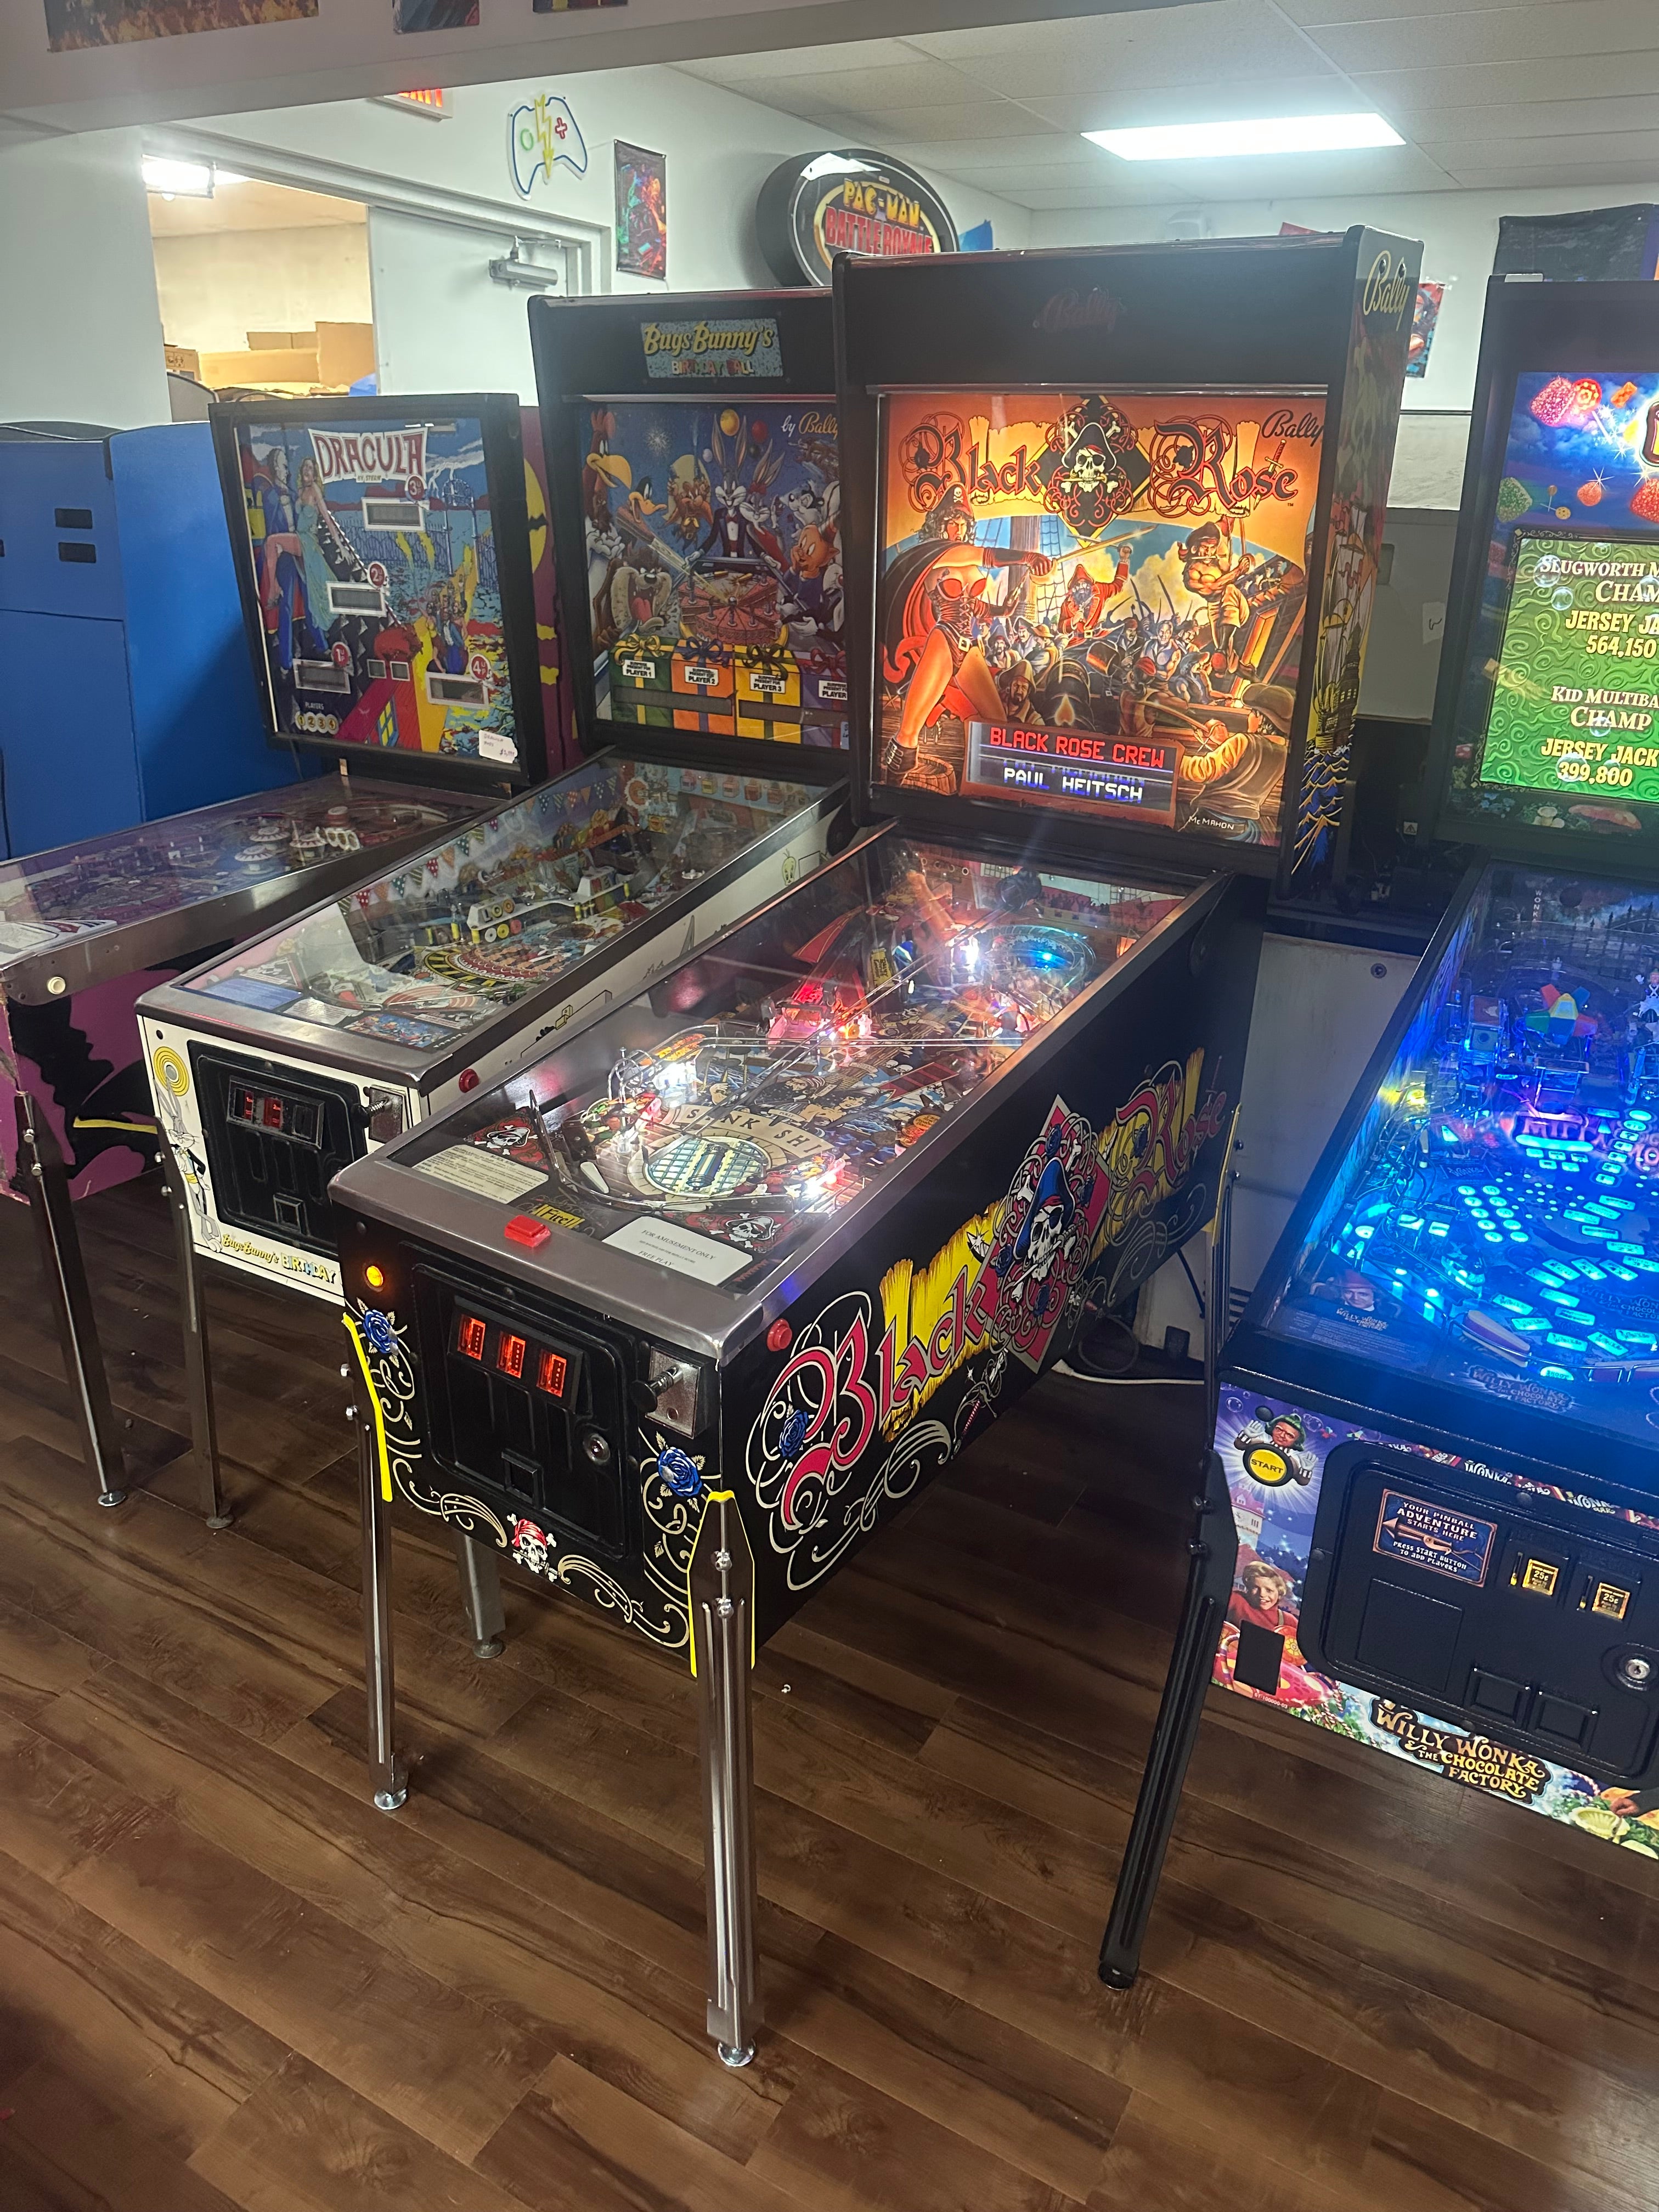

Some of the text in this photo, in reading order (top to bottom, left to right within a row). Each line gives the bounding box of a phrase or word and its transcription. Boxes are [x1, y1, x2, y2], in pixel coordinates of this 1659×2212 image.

[843, 178, 920, 228] PAC-MAN
[825, 205, 933, 256] BATTLE ROYALE
[1363, 250, 1410, 331] Bally
[644, 320, 774, 357] Bugs Bunny's
[671, 358, 755, 375] BIRTHDAY BALL
[781, 411, 838, 440] by Bally
[1262, 409, 1324, 447] Bally
[313, 433, 423, 478] DRACULA
[906, 415, 1299, 509] Black Rose
[1539, 557, 1645, 577] SLUGWORTH
[1565, 610, 1635, 633] JERSEY
[1586, 635, 1657, 658] 564,150
[1551, 686, 1659, 709] KID MULTIBA
[1571, 706, 1652, 731] CHAMP
[990, 727, 1165, 768] BLACK ROSE CREW
[1541, 738, 1659, 767] JERSEY JACK
[1004, 768, 1049, 790] PAUL
[1062, 776, 1143, 804] HEITSCH
[1558, 761, 1633, 787] 399,800
[686, 1109, 760, 1130] SNK
[540, 1209, 575, 1226] Fire!
[222, 1234, 337, 1284] Bugs Bunny's BIRTHDAY
[639, 1250, 675, 1267] FREE PLAY
[641, 1229, 716, 1260] FOR AMUSEMENT ONLY
[767, 1064, 1227, 1536] Black Rose
[1472, 1368, 1569, 1401] WILLY WONKA
[1510, 1389, 1566, 1406] CHOCOLATE
[1514, 1396, 1559, 1409] FACTORY
[1251, 1459, 1284, 1474] START
[1397, 1508, 1478, 1539] ADVENTURE
[1403, 1502, 1475, 1530] YOUR PINBALL
[1407, 1519, 1465, 1542] STARTS HERE
[1393, 1541, 1467, 1570] PRESS START BUTTON
[1427, 1558, 1458, 1573] PLAYERS
[1533, 1570, 1549, 1581] 25¢
[1603, 1593, 1619, 1604] 25¢
[1376, 1703, 1545, 1778] WILLY WONKA
[1418, 1750, 1438, 1762] THE
[1441, 1751, 1540, 1792] CHOCOLATE
[1449, 1766, 1527, 1799] FACTORY
